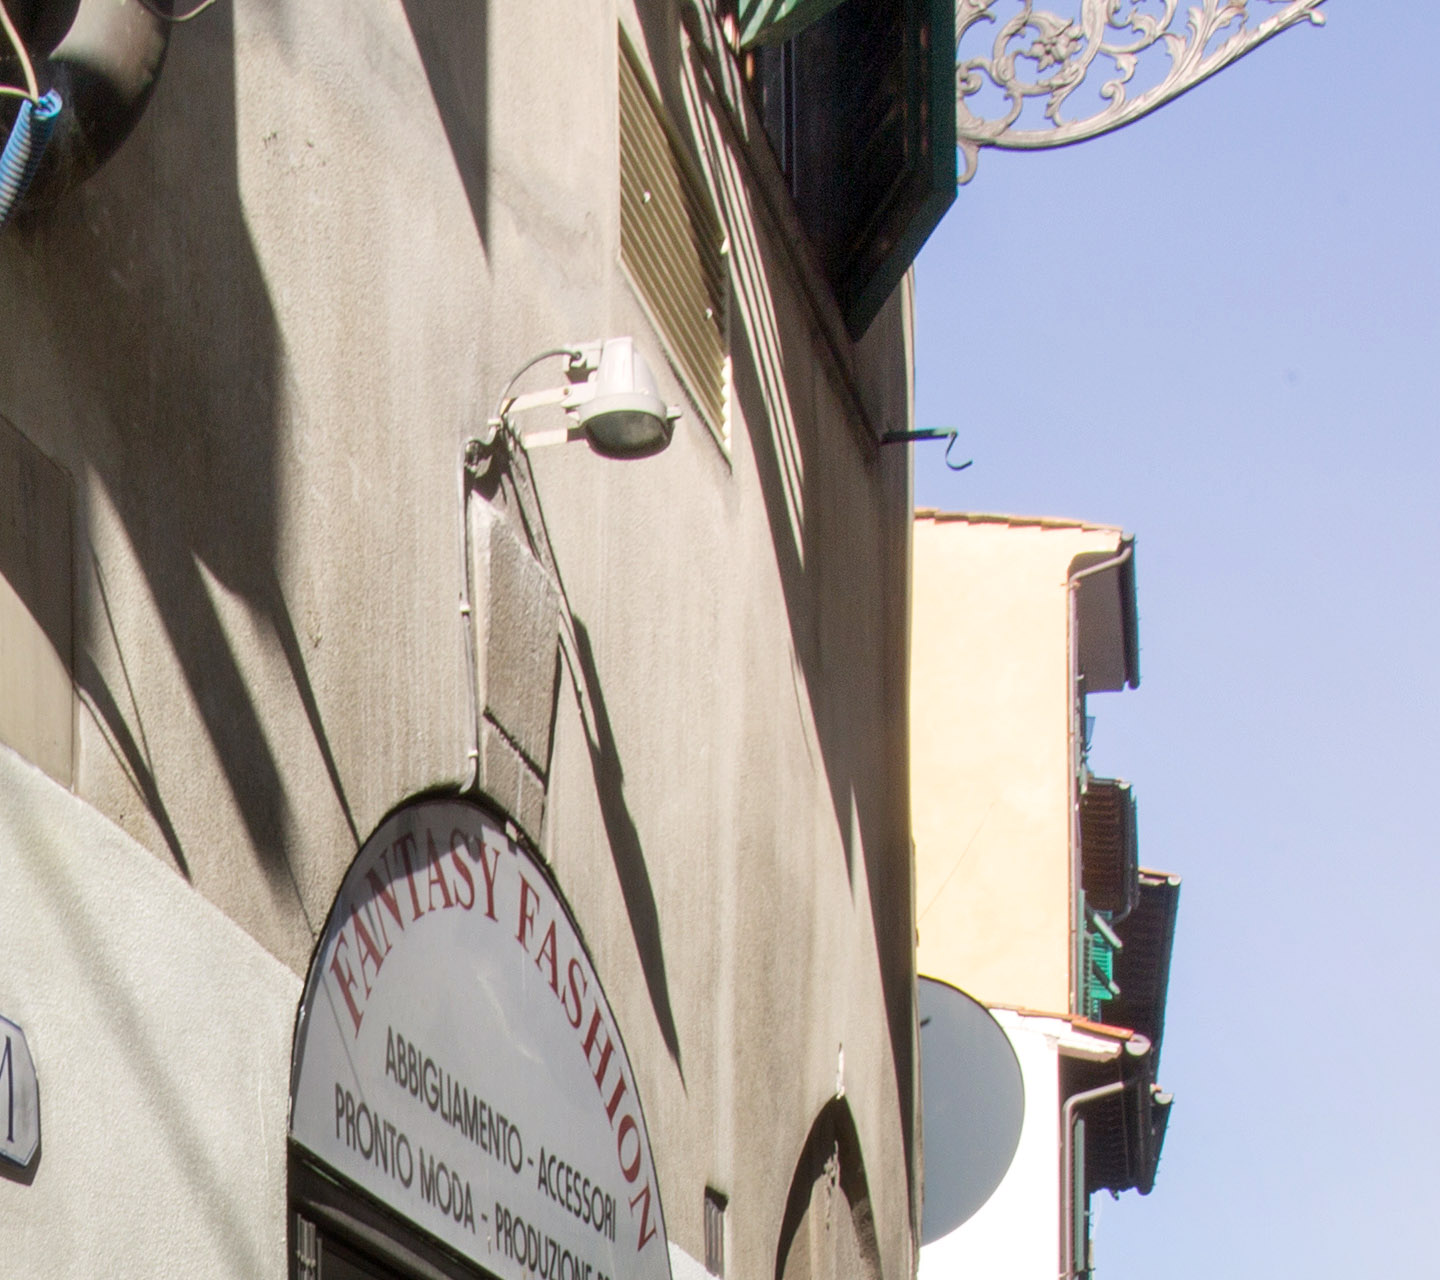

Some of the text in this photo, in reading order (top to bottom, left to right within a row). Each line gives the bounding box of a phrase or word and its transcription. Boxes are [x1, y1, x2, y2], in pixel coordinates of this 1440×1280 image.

[328, 826, 659, 1252] FANTASY FASHION
[385, 1025, 522, 1174] ABBIGLIAMENTO
[538, 1146, 617, 1243] ACCESSORI
[334, 1082, 413, 1189] PRONTO
[420, 1147, 476, 1235] MODA
